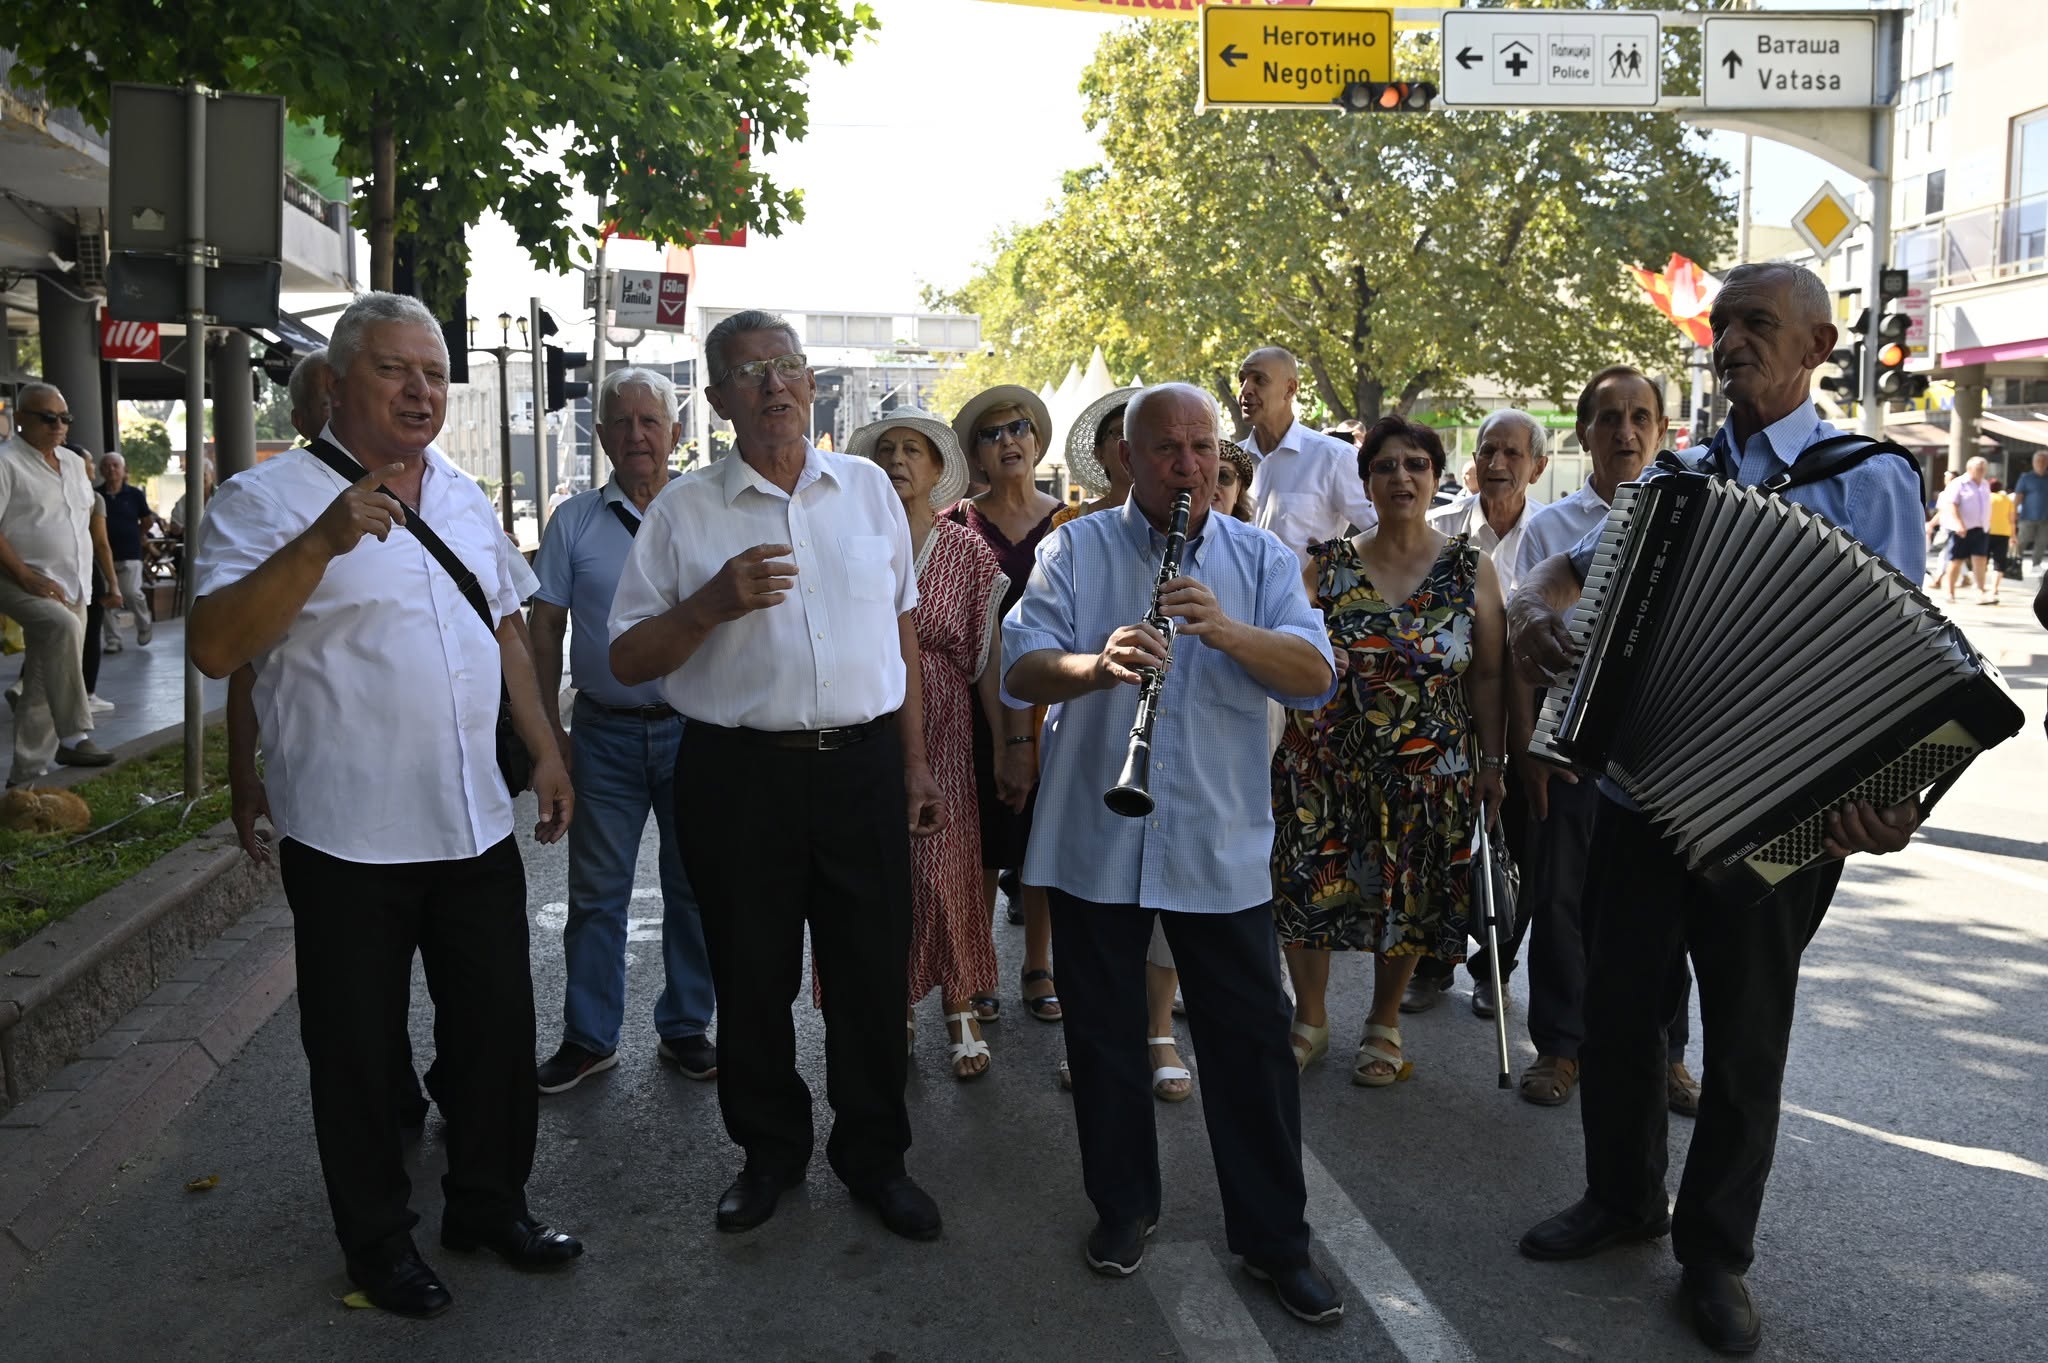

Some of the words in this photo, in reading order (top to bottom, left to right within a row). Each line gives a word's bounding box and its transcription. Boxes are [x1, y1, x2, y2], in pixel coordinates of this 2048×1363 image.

[1263, 25, 1376, 47] Неготино
[1757, 35, 1840, 54] Ваташа
[1551, 43, 1591, 60] Полиција
[1263, 61, 1370, 90] Negotino
[1552, 66, 1590, 79] Police
[623, 275, 634, 290] La
[621, 289, 652, 305] Familia
[105, 320, 156, 355] illy
